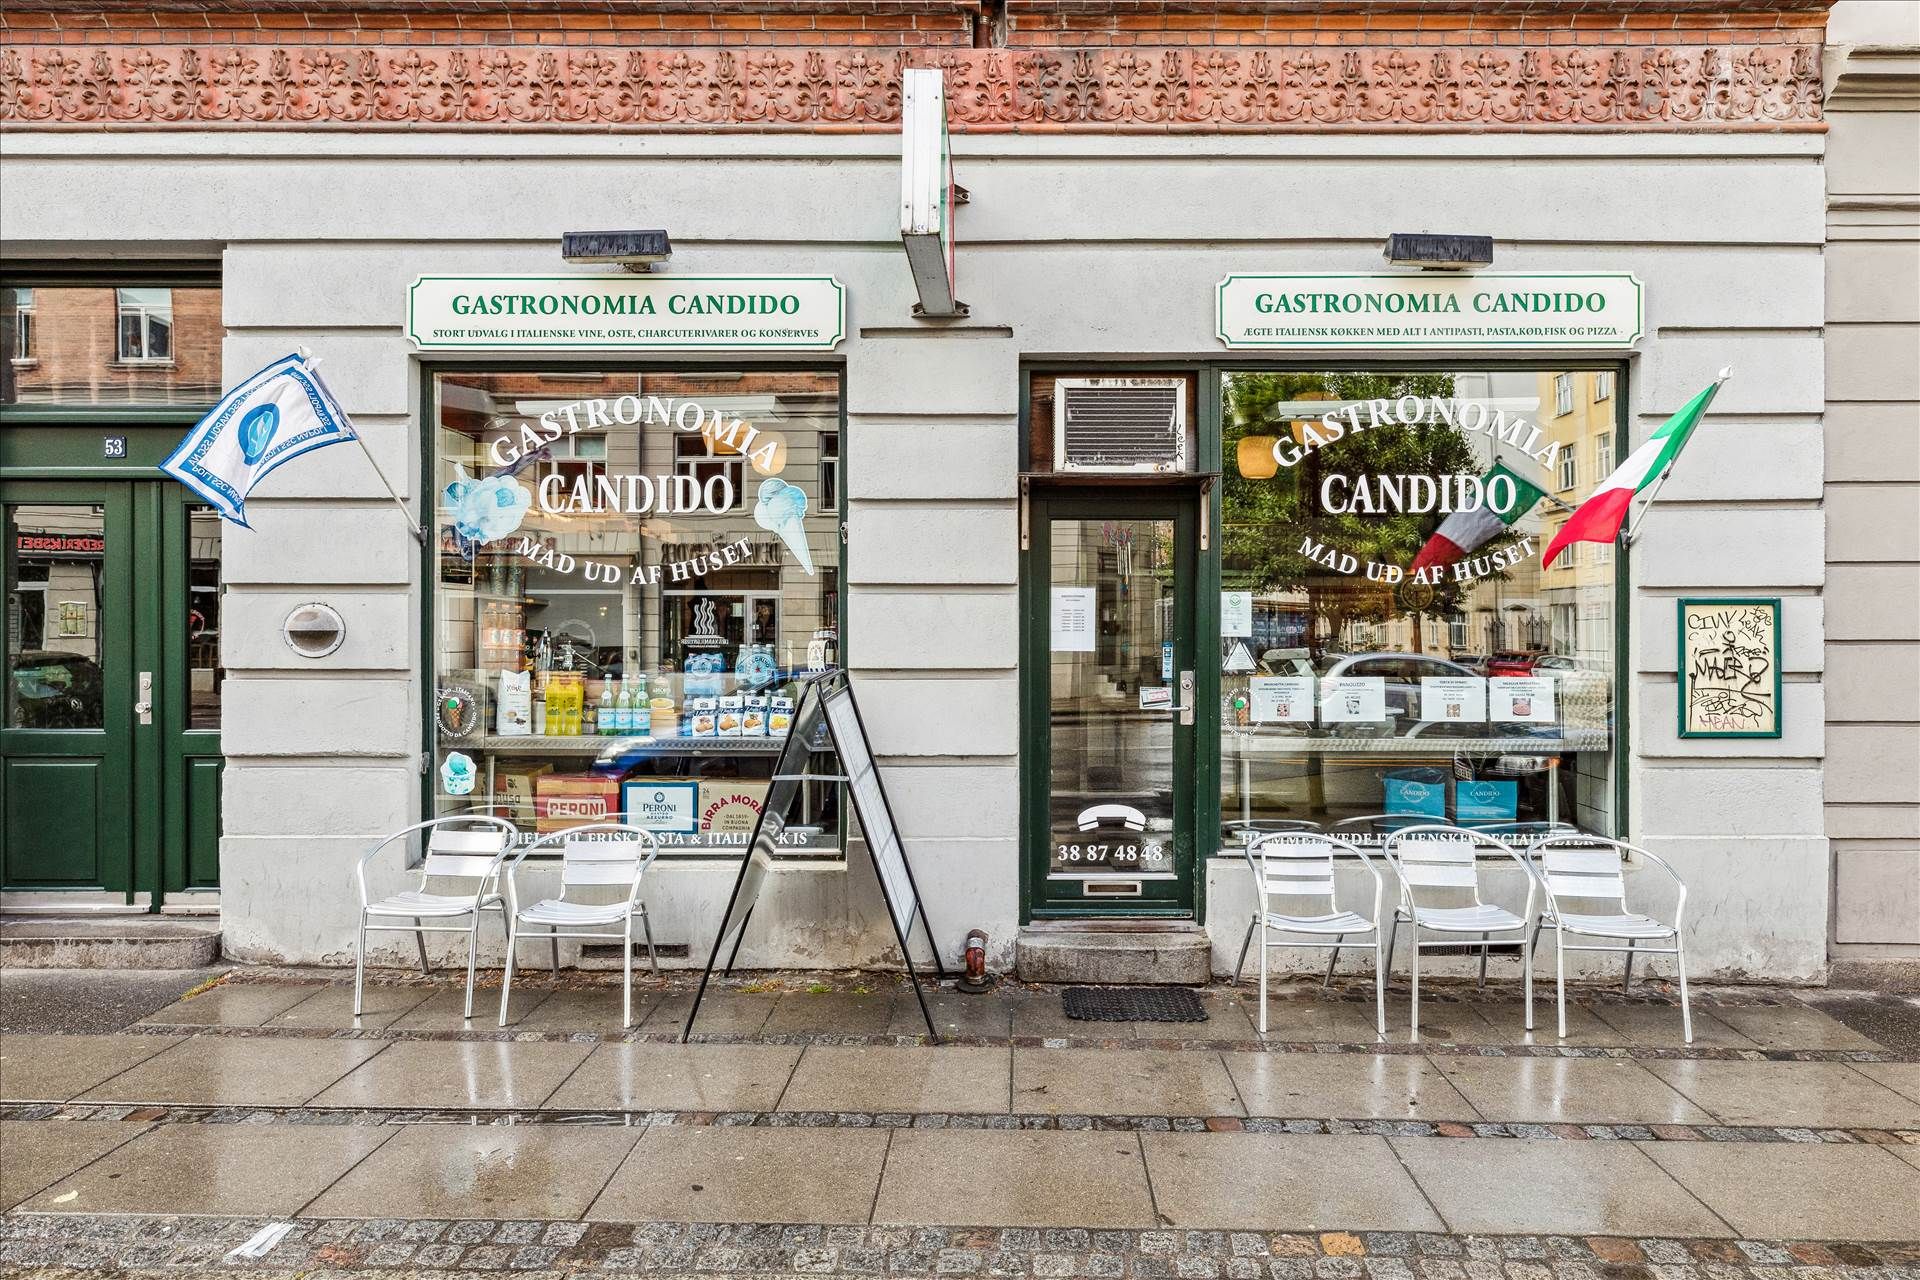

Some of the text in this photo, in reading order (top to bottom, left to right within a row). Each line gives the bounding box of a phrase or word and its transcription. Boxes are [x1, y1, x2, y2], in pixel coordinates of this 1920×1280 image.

[452, 295, 800, 315] GASTRONOMIA CANDIDO
[1255, 293, 1606, 313] GASTRONOMIA CANDIDO
[433, 328, 819, 339] STORT UDVALG I ITALIENSKE VINE, OSTE, CHARCUTERIVARER OG KONSERVES
[1243, 327, 1273, 338] ÆGTE
[1275, 327, 1330, 338] ITALIENSK
[1331, 327, 1375, 338] KØKKEN
[1377, 327, 1401, 338] MED
[1403, 327, 1421, 338] ALT
[1429, 327, 1485, 338] ANTIPASTI,
[1568, 327, 1585, 338] OG
[1586, 327, 1617, 338] PIZZA
[490, 395, 779, 473] GASTRONOMIA
[1272, 395, 1560, 472] GASTRONOMIA
[105, 439, 123, 456] 53
[538, 473, 734, 516] CANDIDO
[1321, 473, 1517, 516] CANDIDO
[515, 536, 576, 576] MAD
[584, 560, 621, 584] UD
[629, 564, 662, 586] AF
[671, 536, 755, 585] HUSET
[1297, 536, 1537, 586] MAD UD AF HUSET
[462, 711, 477, 735] CANDIDO
[549, 802, 605, 816] PERONI
[642, 803, 677, 812] PERONI
[701, 797, 730, 831] BIRRA
[690, 834, 702, 845] &
[794, 833, 808, 845] IS
[1058, 844, 1163, 861] 38 87 48 48
